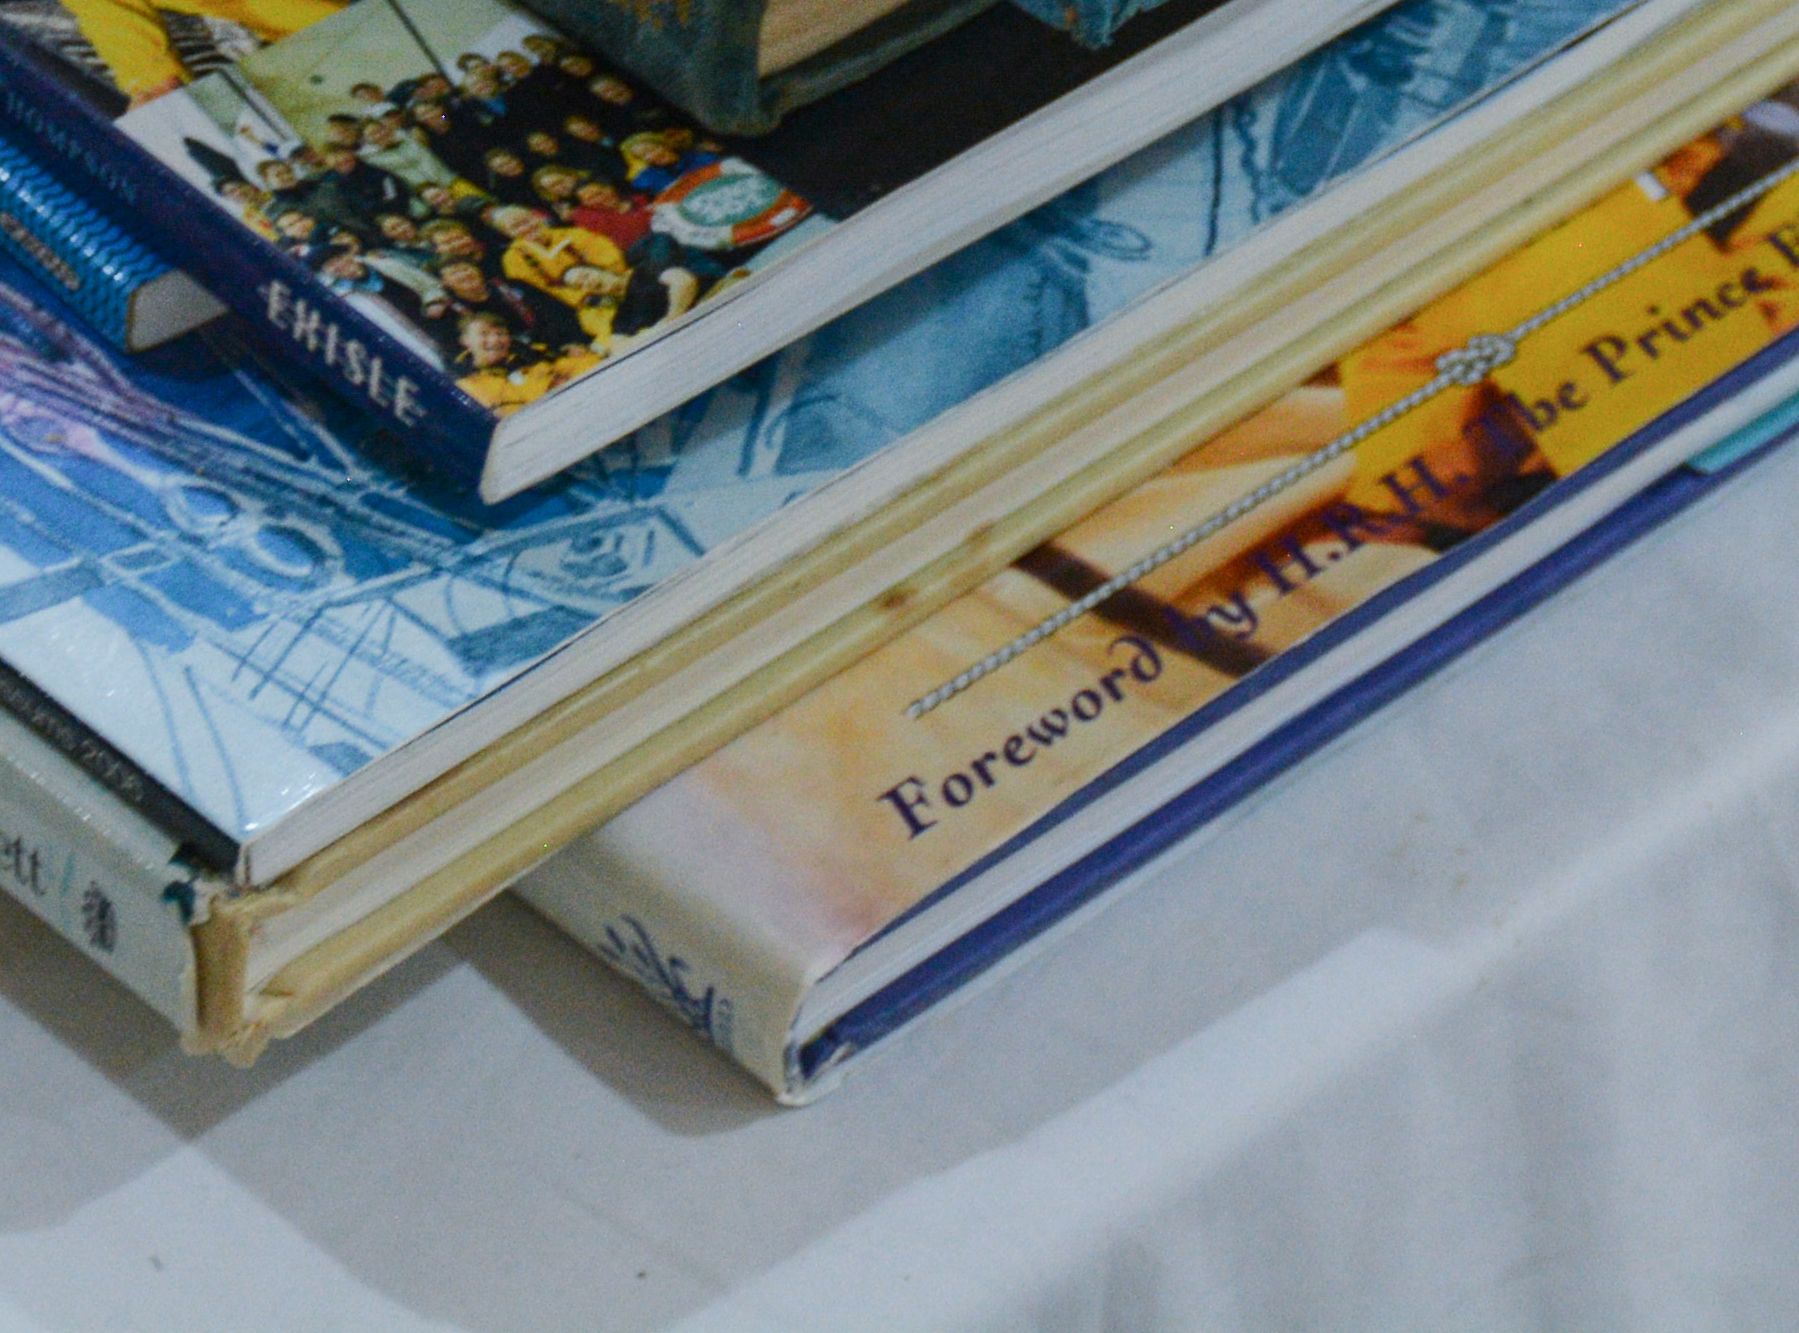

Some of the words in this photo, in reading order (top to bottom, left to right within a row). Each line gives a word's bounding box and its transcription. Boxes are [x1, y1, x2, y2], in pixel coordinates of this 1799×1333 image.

[264, 278, 430, 428] EXISLE
[876, 633, 1169, 841] Foreword
[1264, 447, 1477, 600] H.R.H.
[1464, 375, 1592, 468] The
[1580, 263, 1774, 391] Prince
